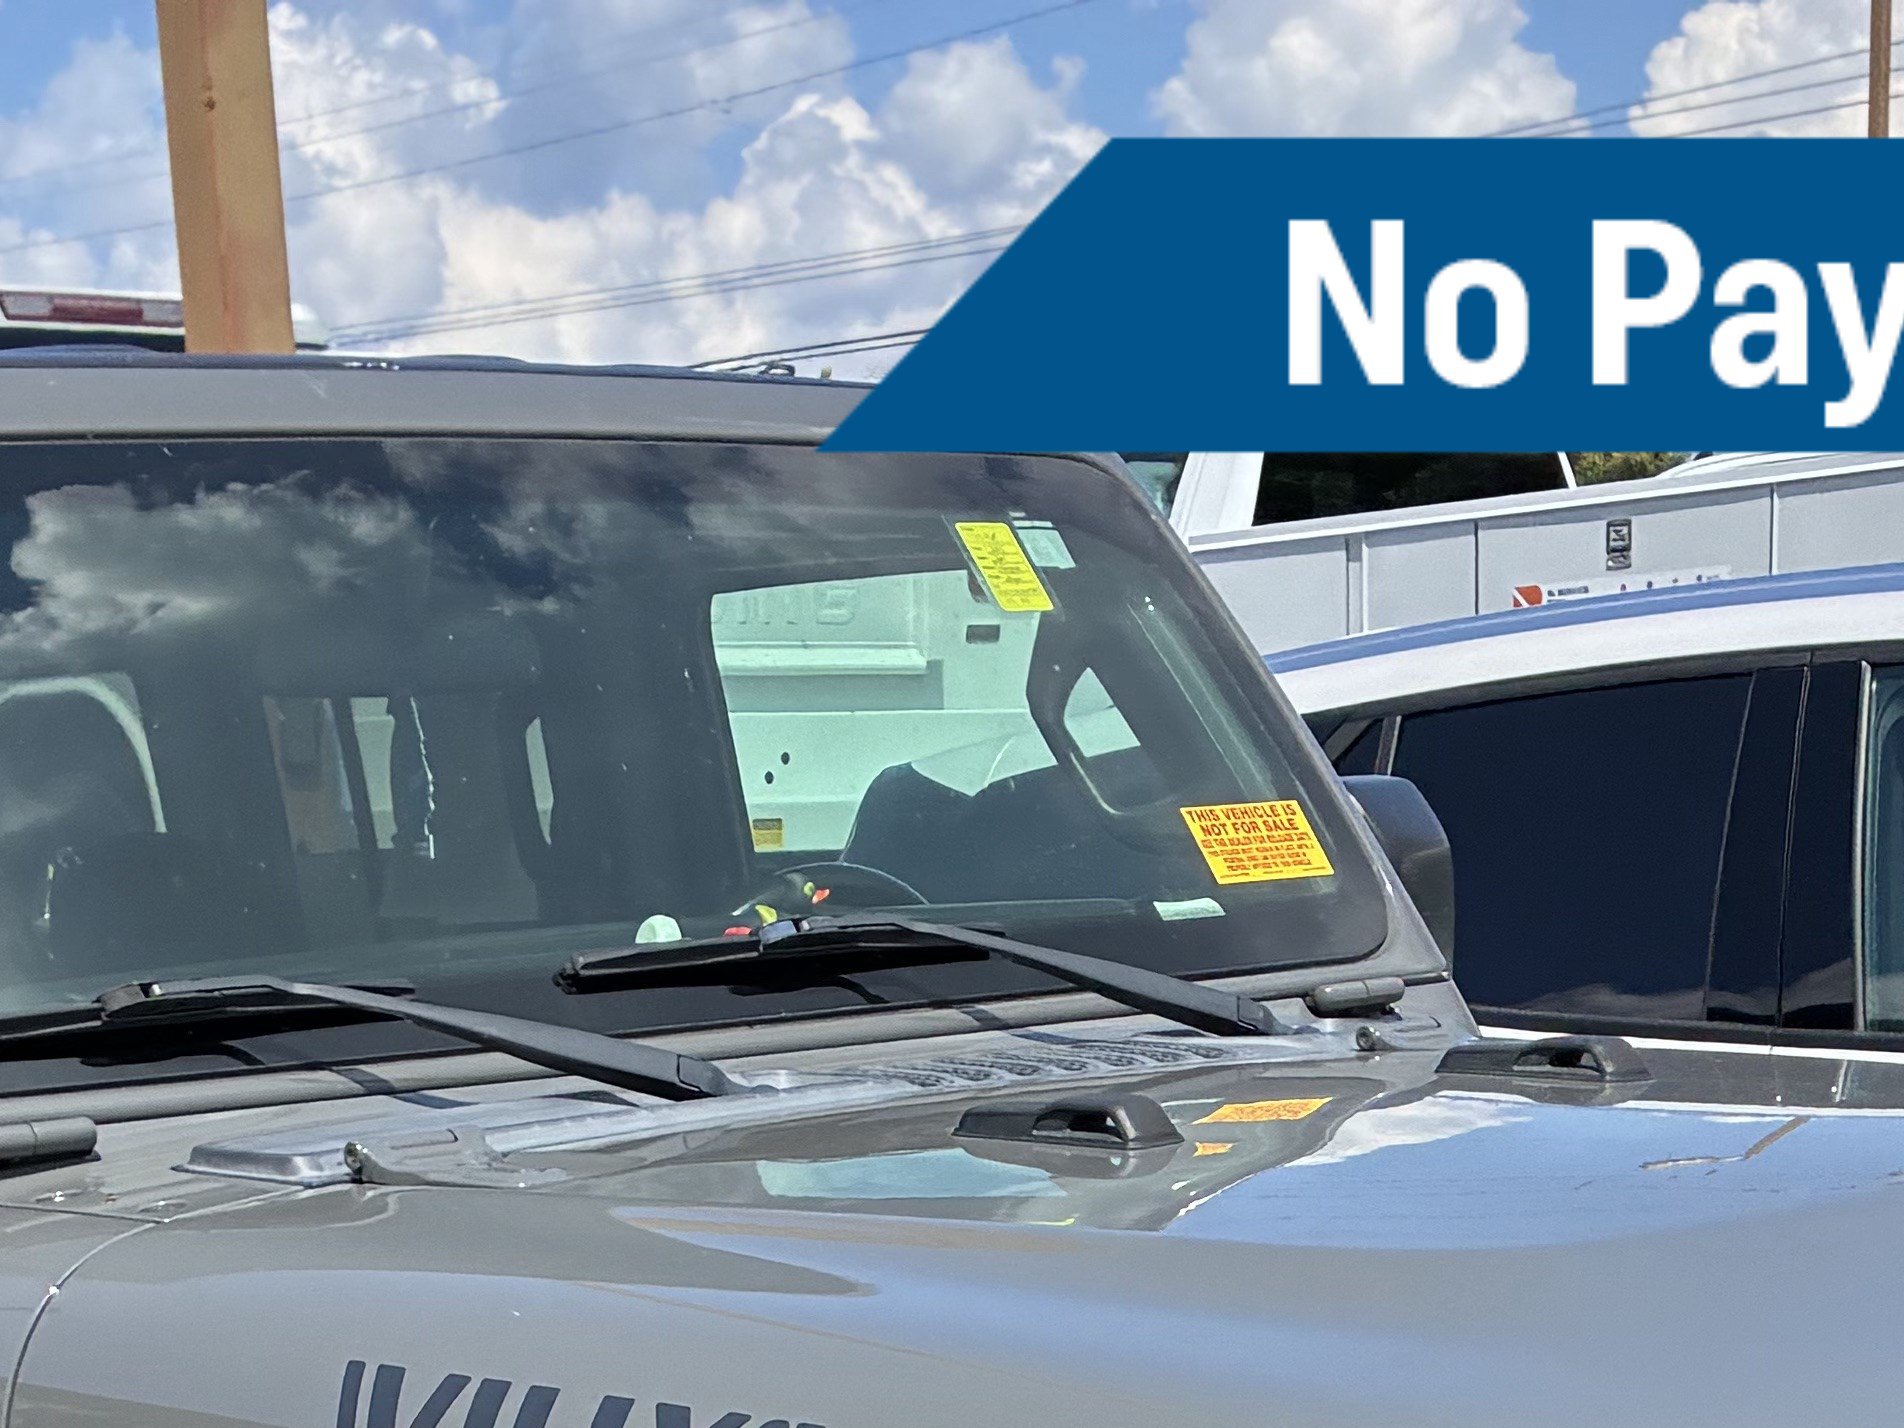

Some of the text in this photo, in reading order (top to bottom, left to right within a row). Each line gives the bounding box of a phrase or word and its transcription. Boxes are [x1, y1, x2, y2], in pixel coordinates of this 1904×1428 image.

[1185, 803, 1297, 824] THIS VEHICLE IS
[1199, 817, 1300, 837] NOT FOR SALE
